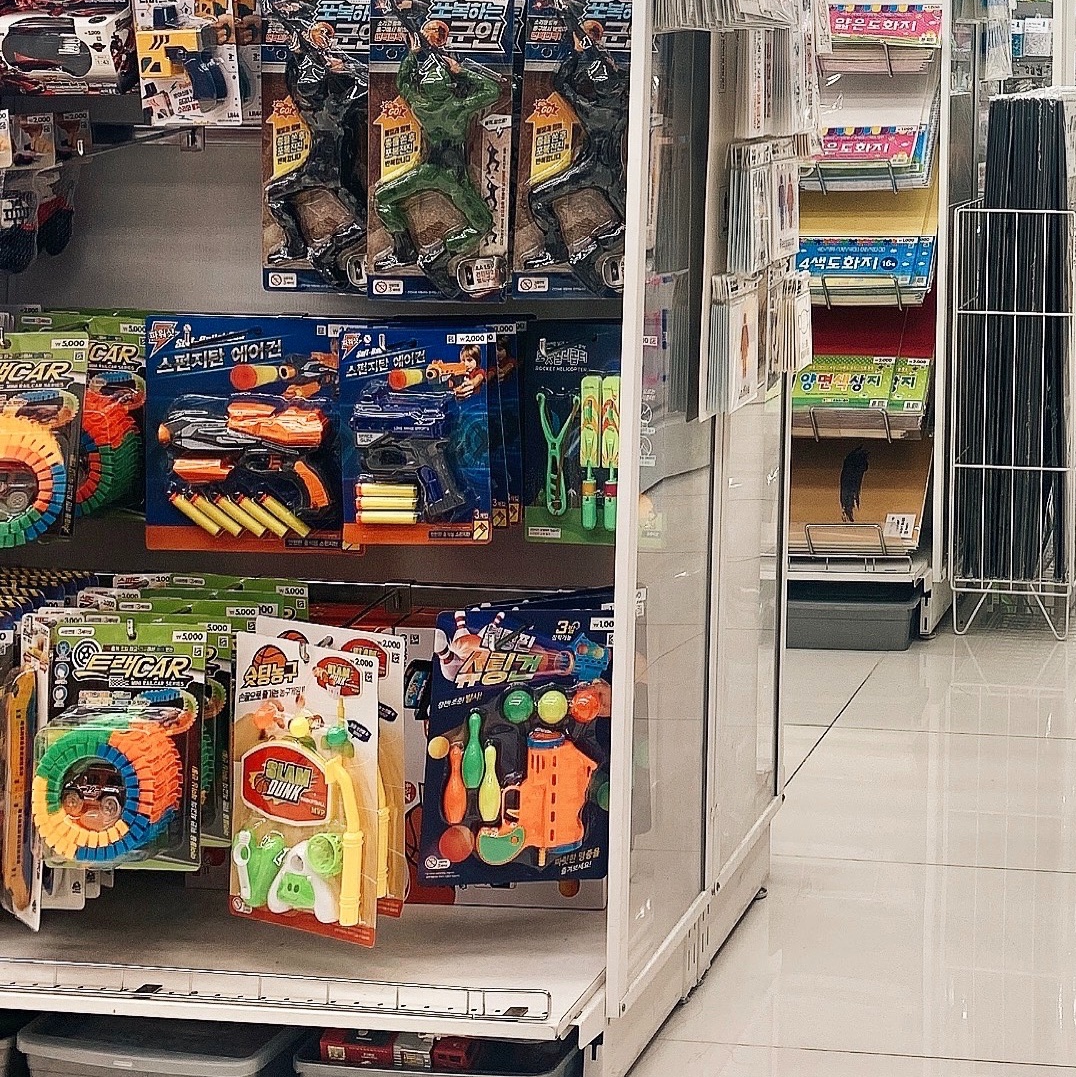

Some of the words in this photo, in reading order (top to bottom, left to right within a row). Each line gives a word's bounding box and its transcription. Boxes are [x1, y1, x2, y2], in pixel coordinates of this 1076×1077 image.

[431, 0, 504, 20] 포복하는
[157, 348, 225, 374] 스펀지탄
[231, 339, 282, 364] 에어건
[346, 358, 389, 378] 스펀지탄
[392, 348, 426, 368] 에어건
[800, 373, 881, 392] 양면색상지
[455, 649, 543, 688] 슈팅건
[265, 760, 312, 788] SLAM
[267, 779, 304, 802] DUNK
[311, 807, 325, 817] MVP
